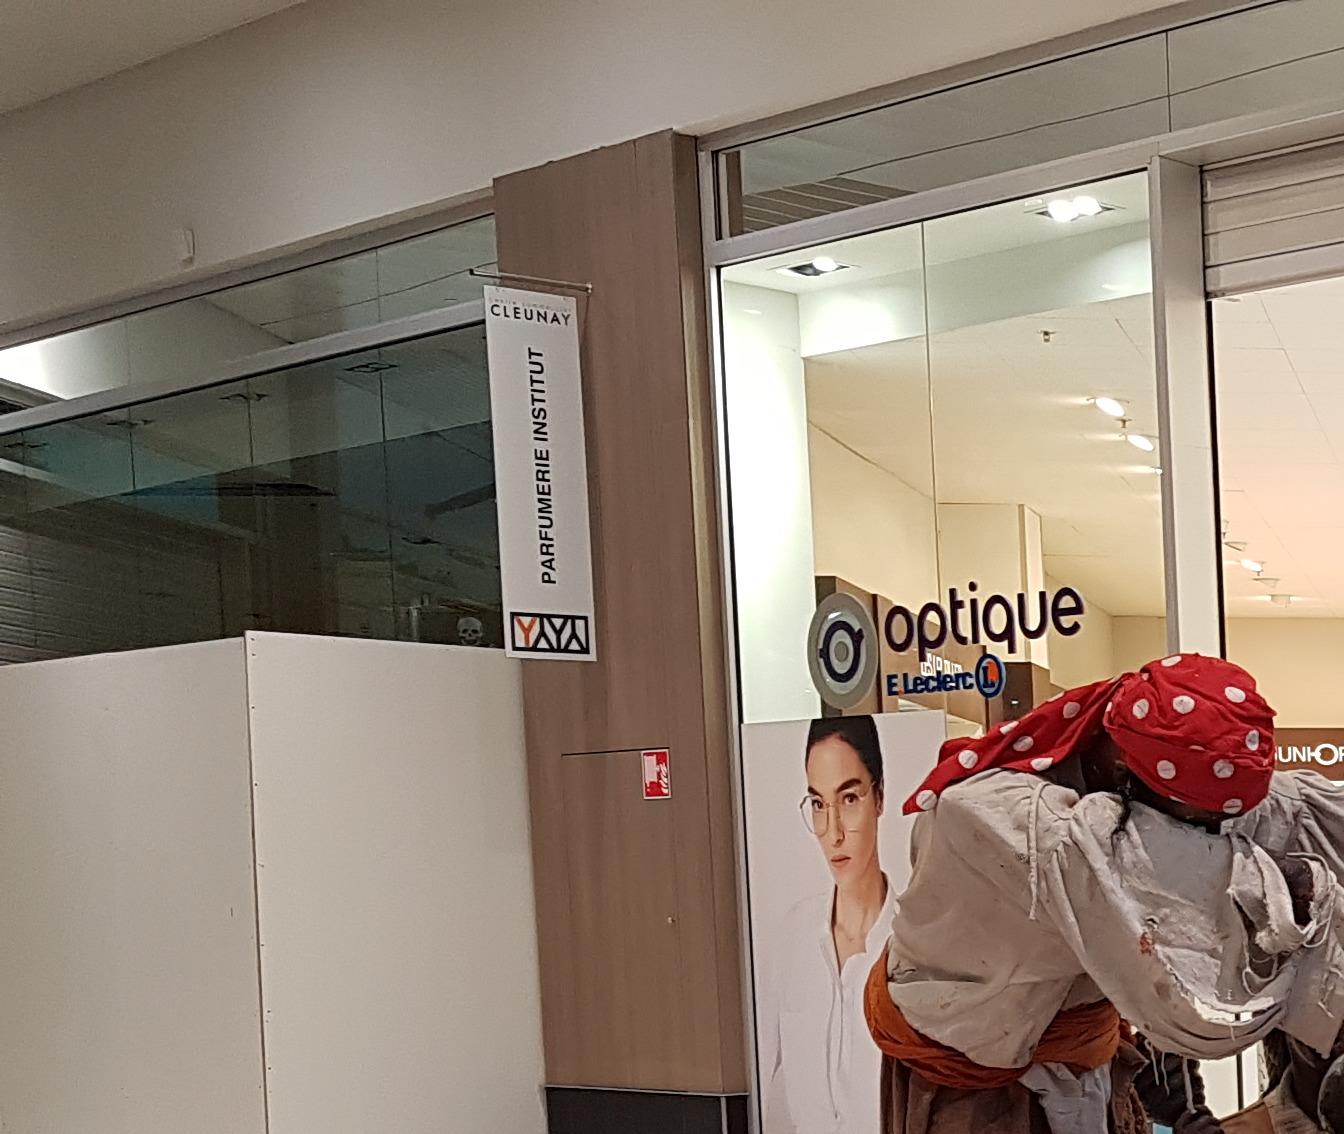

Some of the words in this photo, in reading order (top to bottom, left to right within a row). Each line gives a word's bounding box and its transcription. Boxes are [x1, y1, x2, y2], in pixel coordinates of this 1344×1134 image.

[490, 304, 571, 326] CLEUNAY
[527, 346, 549, 442] INSTITUT
[533, 448, 557, 585] PARFUMERIE
[885, 581, 1085, 662] optique
